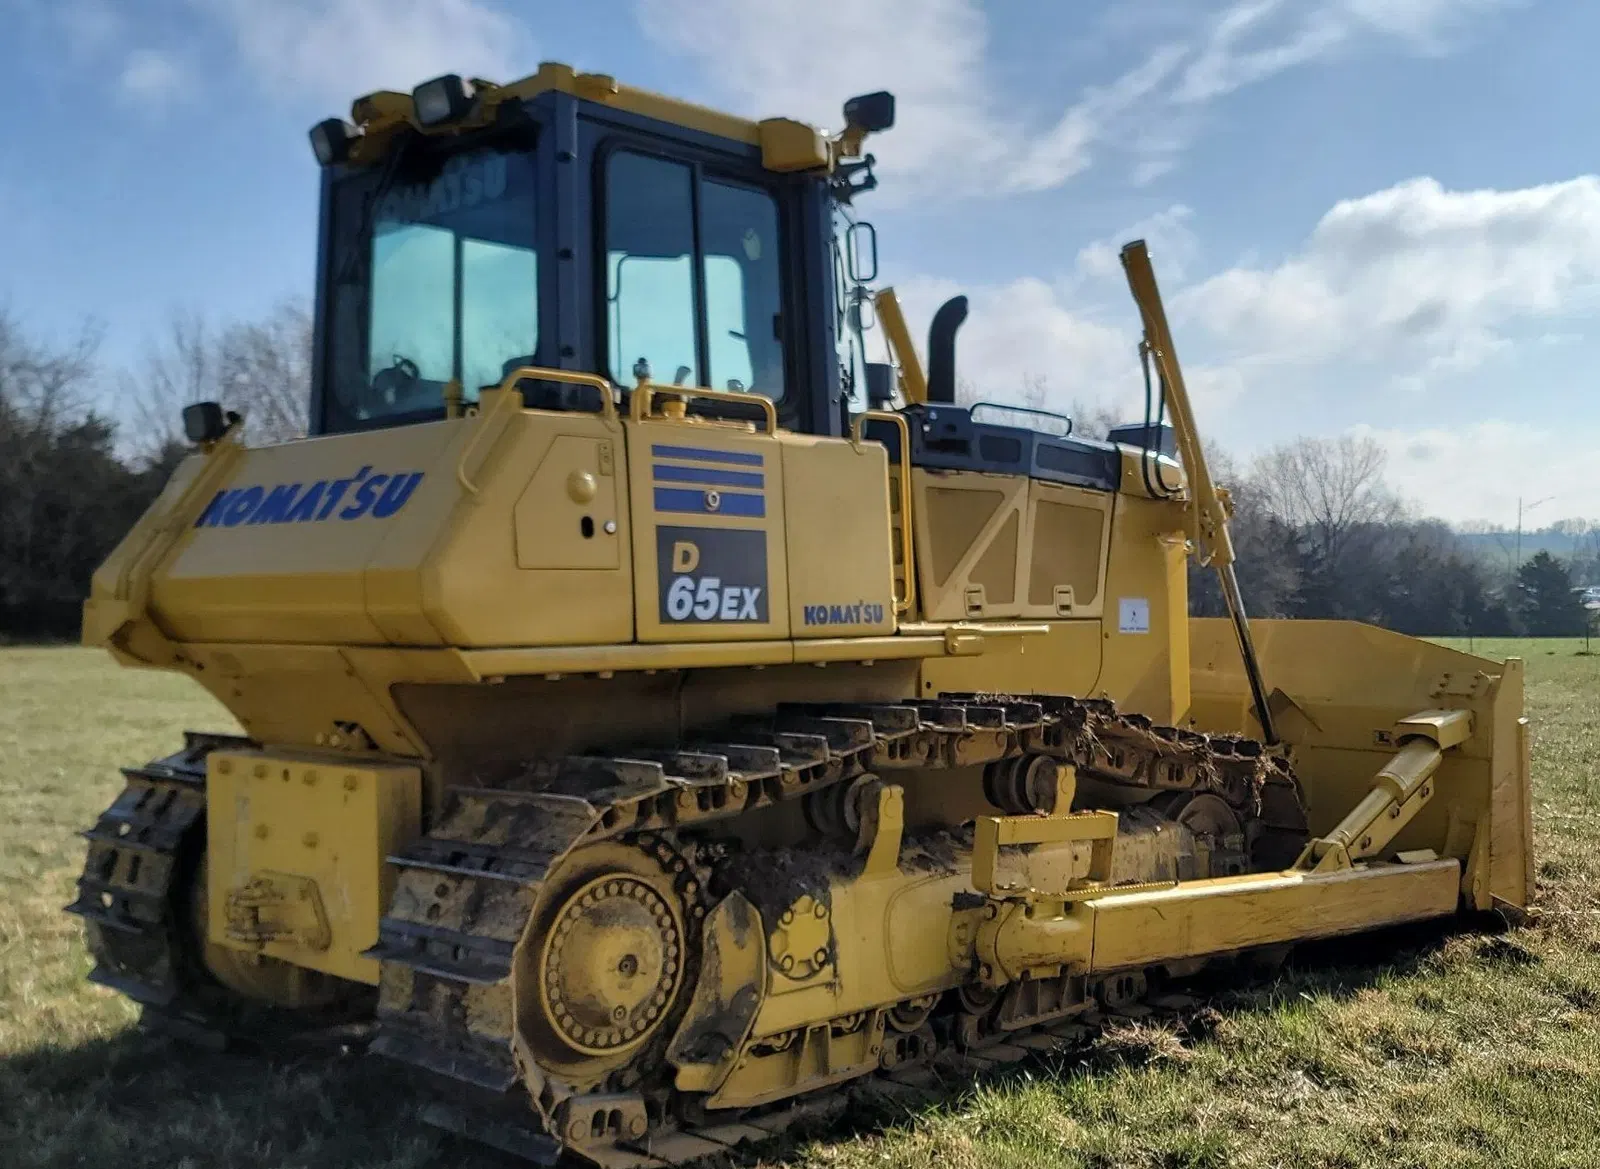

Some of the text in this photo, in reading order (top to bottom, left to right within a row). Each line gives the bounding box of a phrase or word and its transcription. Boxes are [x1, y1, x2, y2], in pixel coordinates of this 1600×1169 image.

[193, 465, 425, 528] KOMATSU
[672, 541, 700, 573] D
[667, 577, 761, 621] 65EX
[804, 600, 883, 625] KOMATSU
